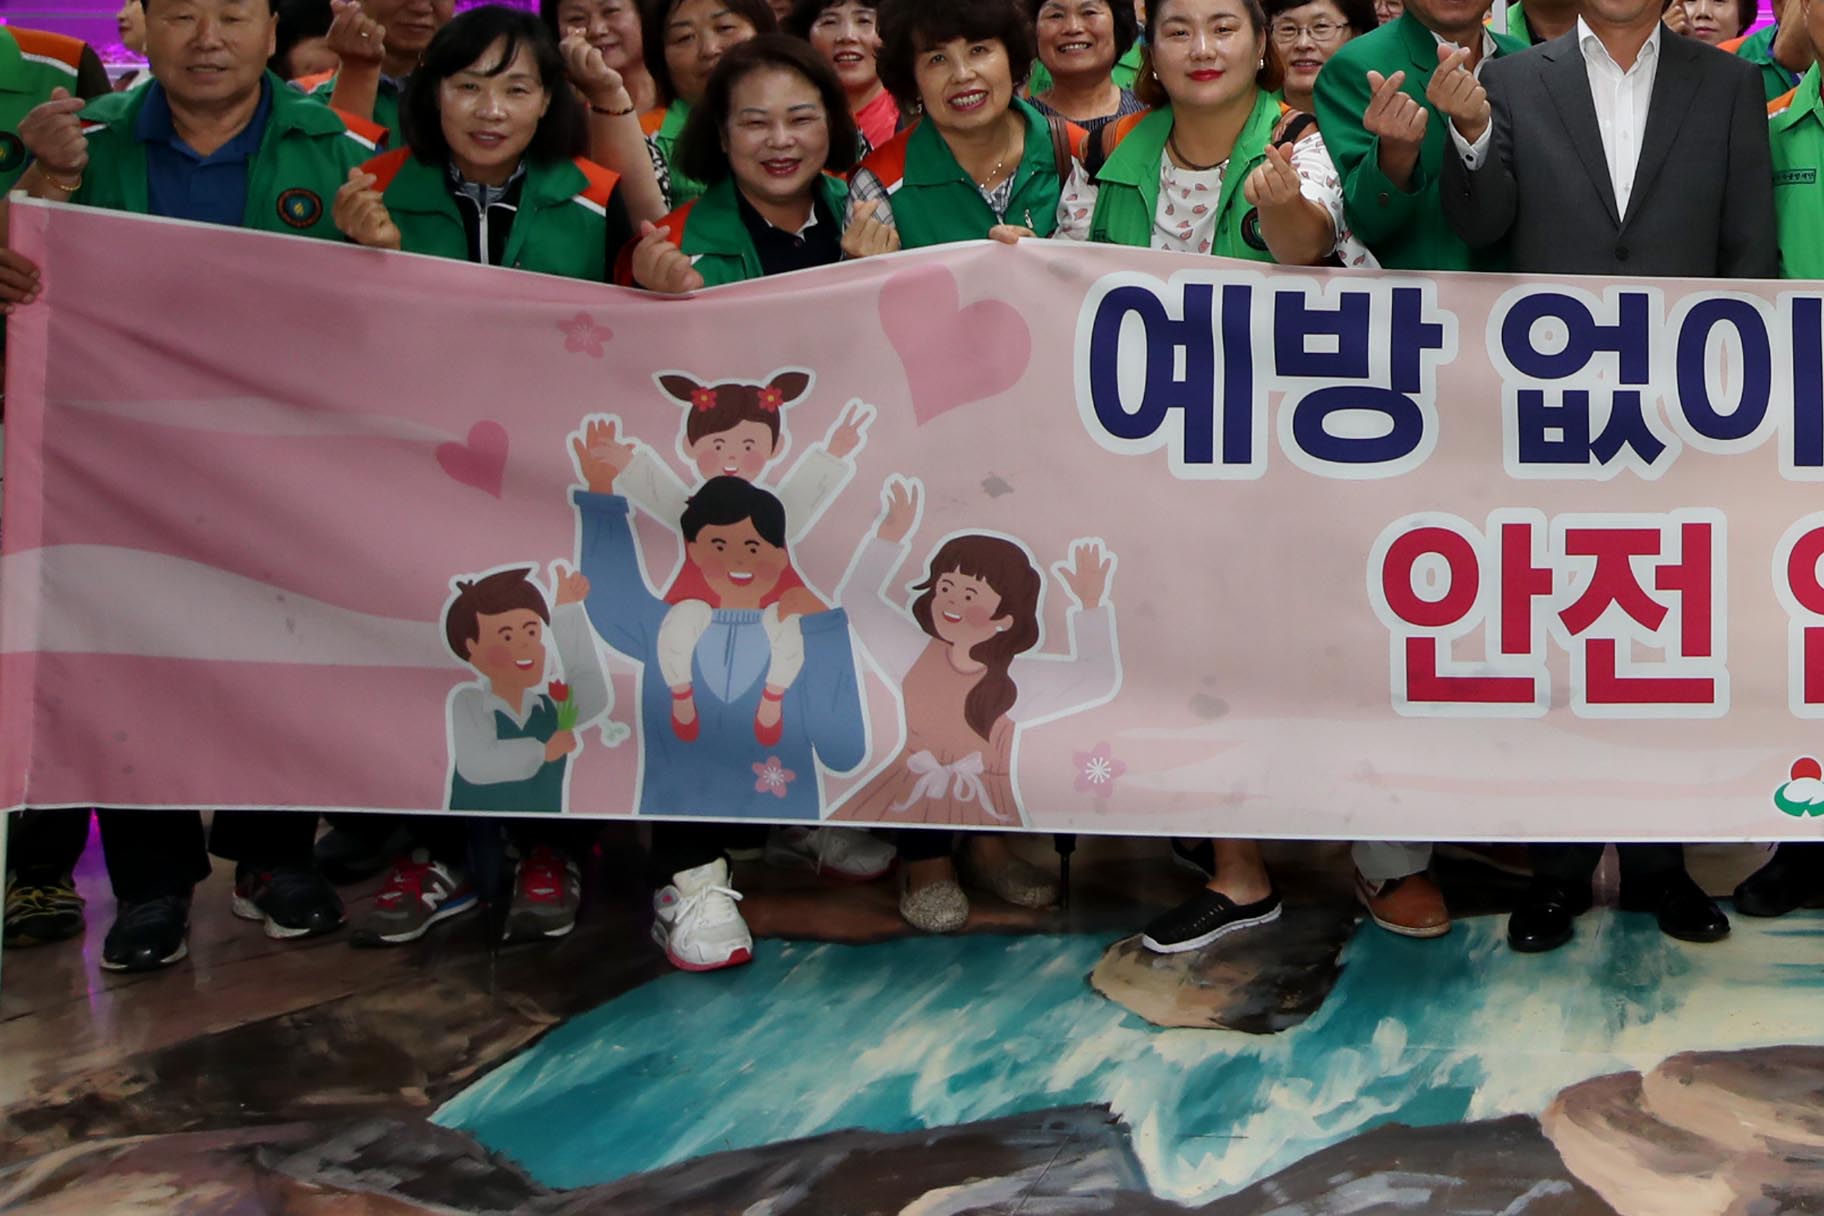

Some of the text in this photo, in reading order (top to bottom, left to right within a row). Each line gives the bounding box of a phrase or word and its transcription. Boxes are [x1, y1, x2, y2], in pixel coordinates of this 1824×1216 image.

[1089, 283, 1443, 464] 예방
[1501, 292, 1824, 466] 없이
[1382, 523, 1715, 704] 안전
